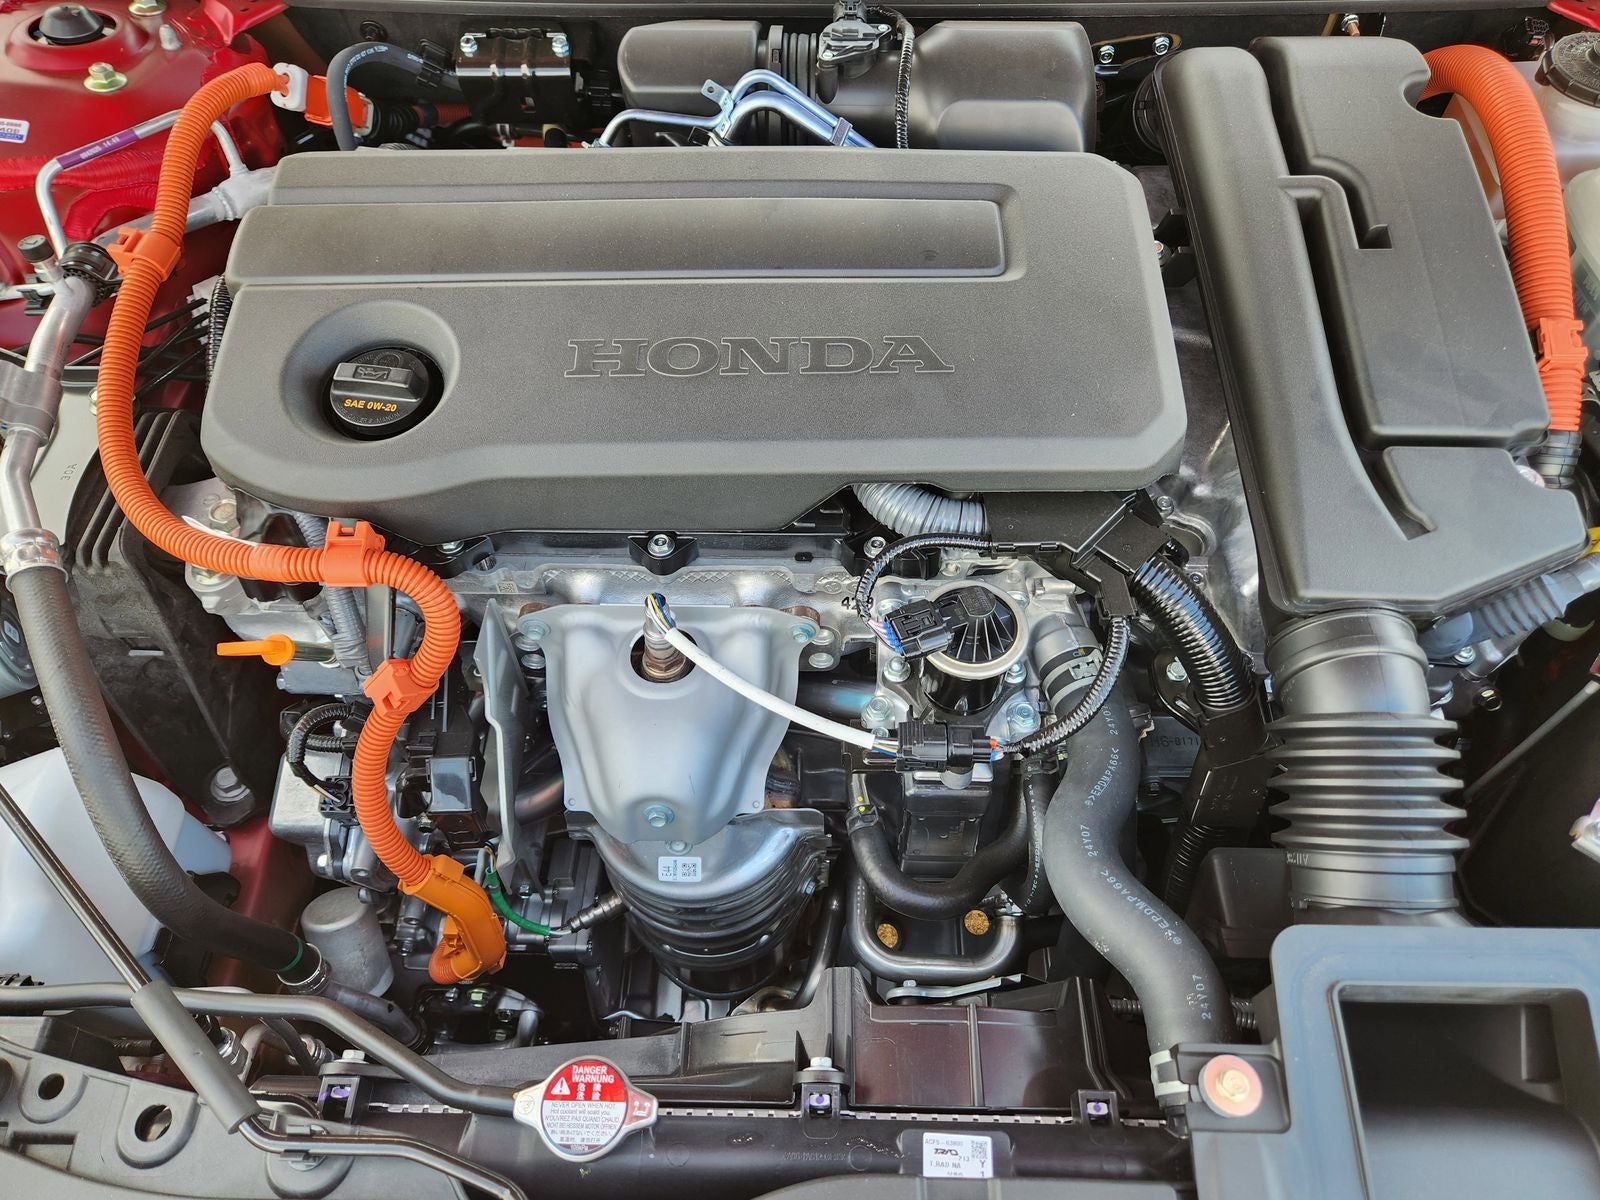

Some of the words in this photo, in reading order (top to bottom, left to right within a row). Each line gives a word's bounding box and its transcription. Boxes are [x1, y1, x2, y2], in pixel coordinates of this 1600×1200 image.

[564, 335, 955, 377] HONDA
[344, 399, 365, 408] SAE
[367, 401, 397, 412] 0W-20
[1080, 824, 1098, 857] 24Y07
[571, 1065, 608, 1075] DANGER
[571, 1074, 615, 1084] WARNUNG
[979, 1159, 986, 1168] Y
